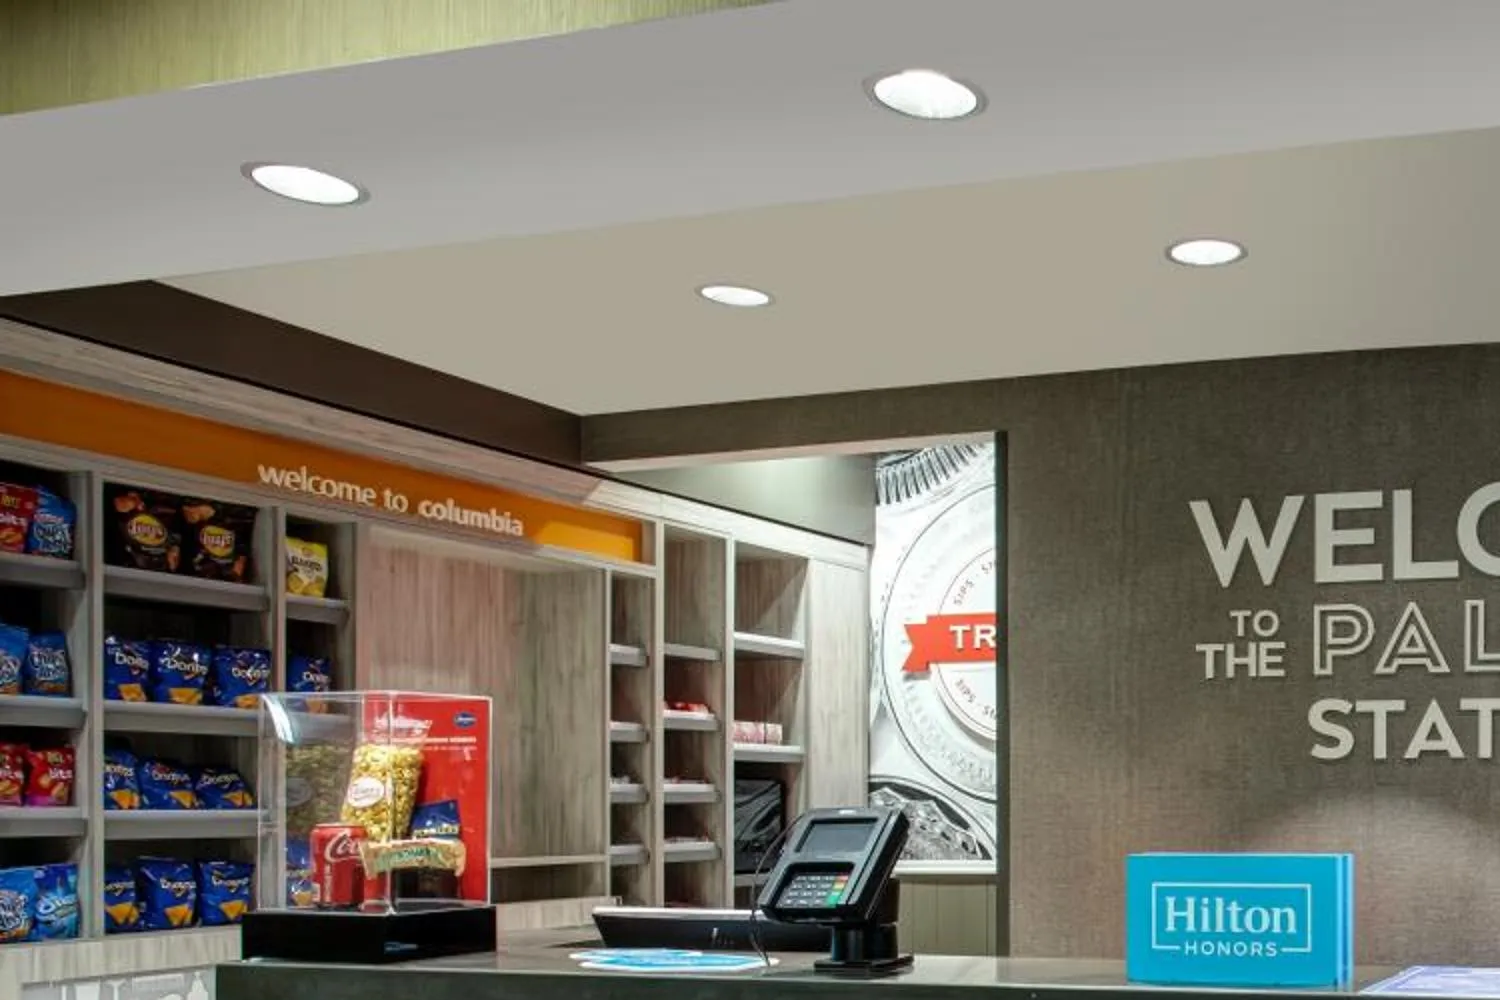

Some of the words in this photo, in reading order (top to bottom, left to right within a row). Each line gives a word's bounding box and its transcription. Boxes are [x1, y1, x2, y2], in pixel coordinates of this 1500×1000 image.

[257, 464, 377, 507] welcome
[383, 488, 409, 514] to
[418, 497, 524, 537] columbia
[1229, 608, 1280, 638] TO
[1195, 641, 1286, 680] THE
[1163, 895, 1298, 934] Hilton
[1184, 940, 1279, 958] HONORS
